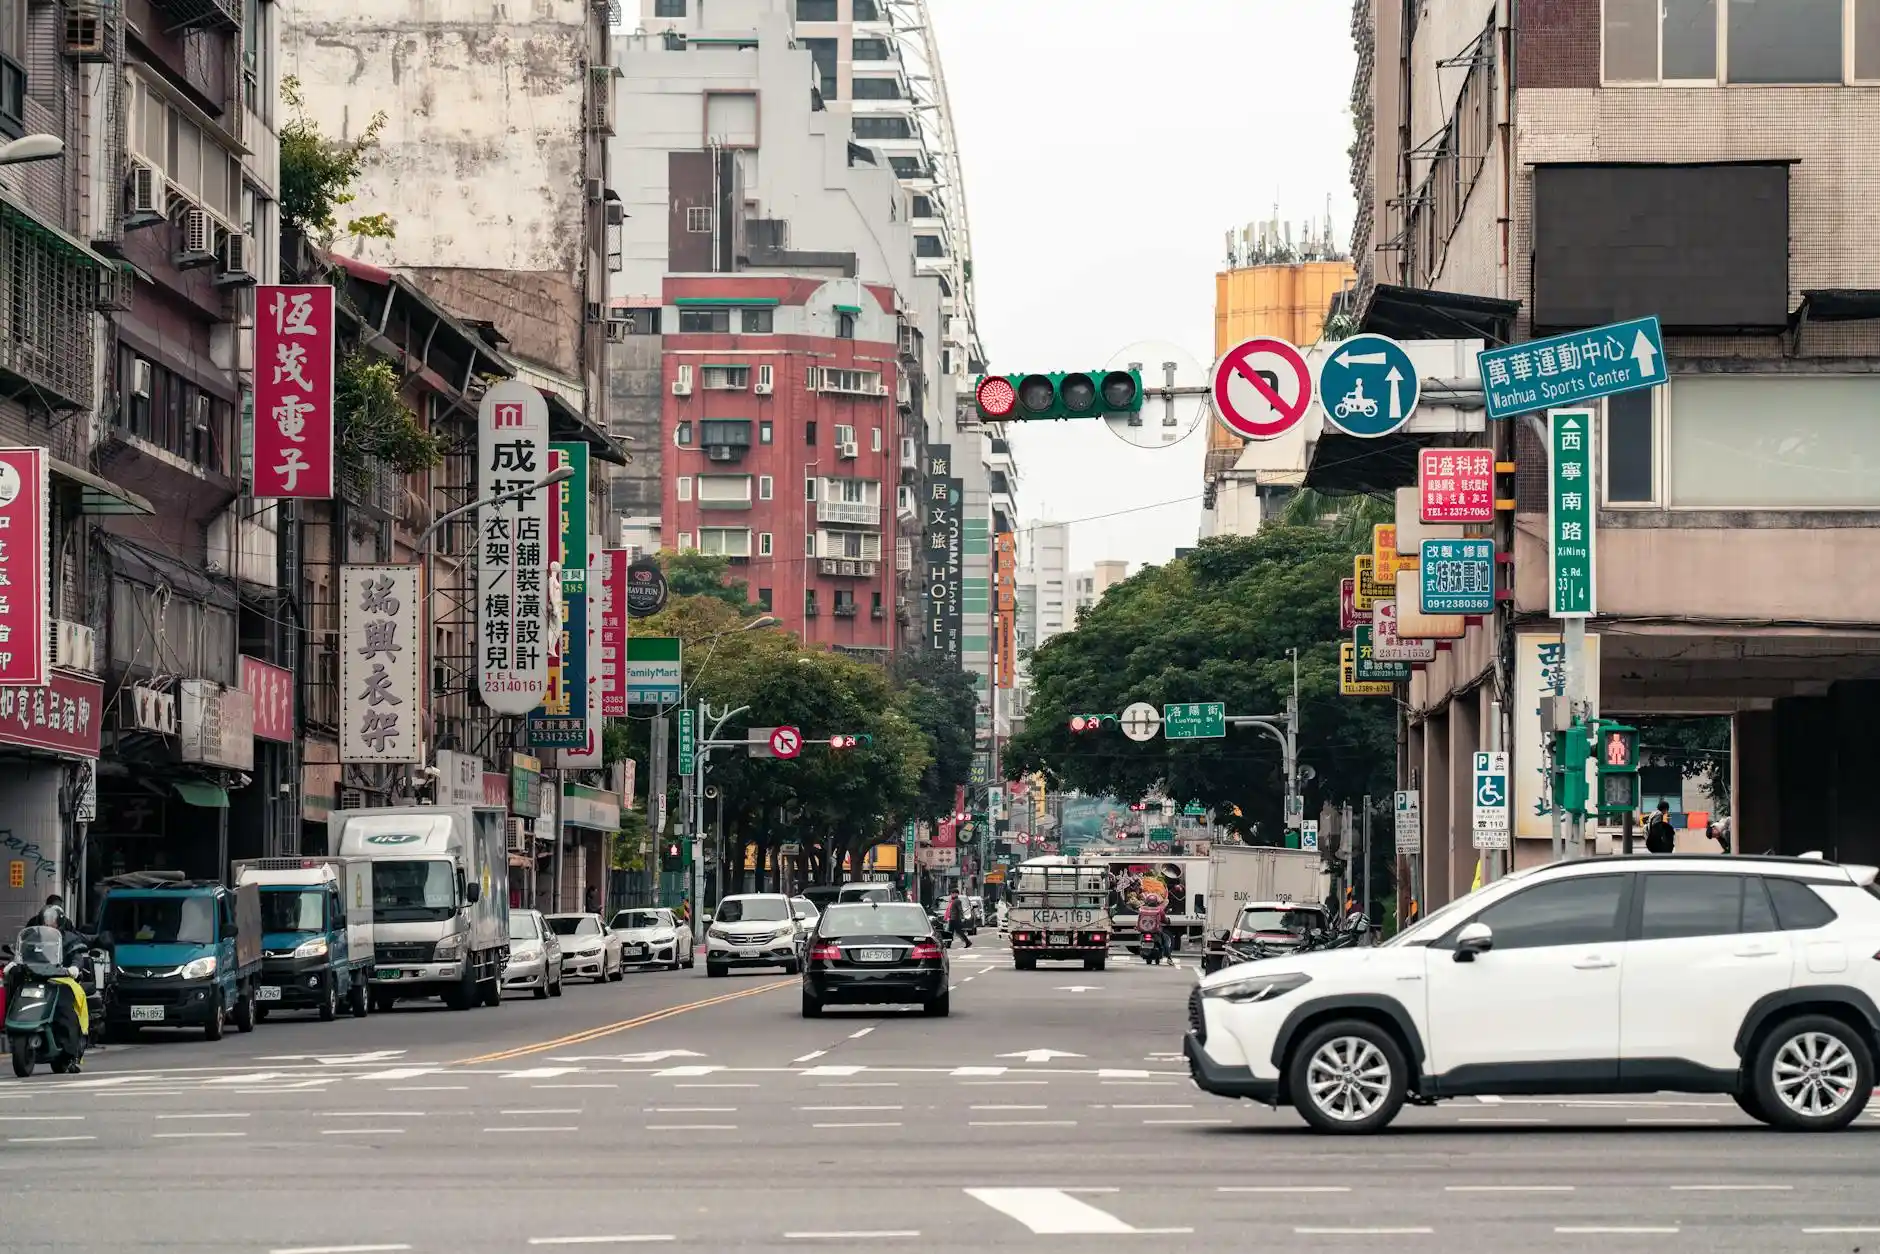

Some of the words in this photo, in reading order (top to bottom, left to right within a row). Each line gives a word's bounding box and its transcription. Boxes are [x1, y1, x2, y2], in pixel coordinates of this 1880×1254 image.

[1485, 335, 1625, 389] 萬華運動中心
[1492, 388, 1536, 409] Wanhua
[1541, 377, 1585, 400] Sports
[1589, 367, 1630, 388] Center
[1426, 456, 1489, 476] 日盛科技
[490, 440, 537, 512] 成坪
[1561, 431, 1582, 541] 西寧南路
[931, 458, 947, 549] 旅居文旅
[1558, 546, 1586, 558] XiNing
[1426, 562, 1435, 592] 各式
[1436, 560, 1489, 592] 特殊電池
[1562, 568, 1569, 577] S.
[1570, 567, 1583, 577] Rd.
[645, 587, 659, 596] FUN
[1578, 587, 1584, 601] 4
[931, 567, 946, 649] HOTEL
[1427, 599, 1489, 608] 0912380369
[1379, 649, 1431, 658] 2371-1552
[357, 574, 403, 753] 瑞興衣架
[485, 672, 518, 680] TEL
[627, 667, 678, 680] FamilyMart
[485, 680, 543, 693] 23140161
[1170, 705, 1218, 717] 洛陽街
[532, 732, 584, 742] 23312355
[1033, 909, 1092, 923] KEA-1169
